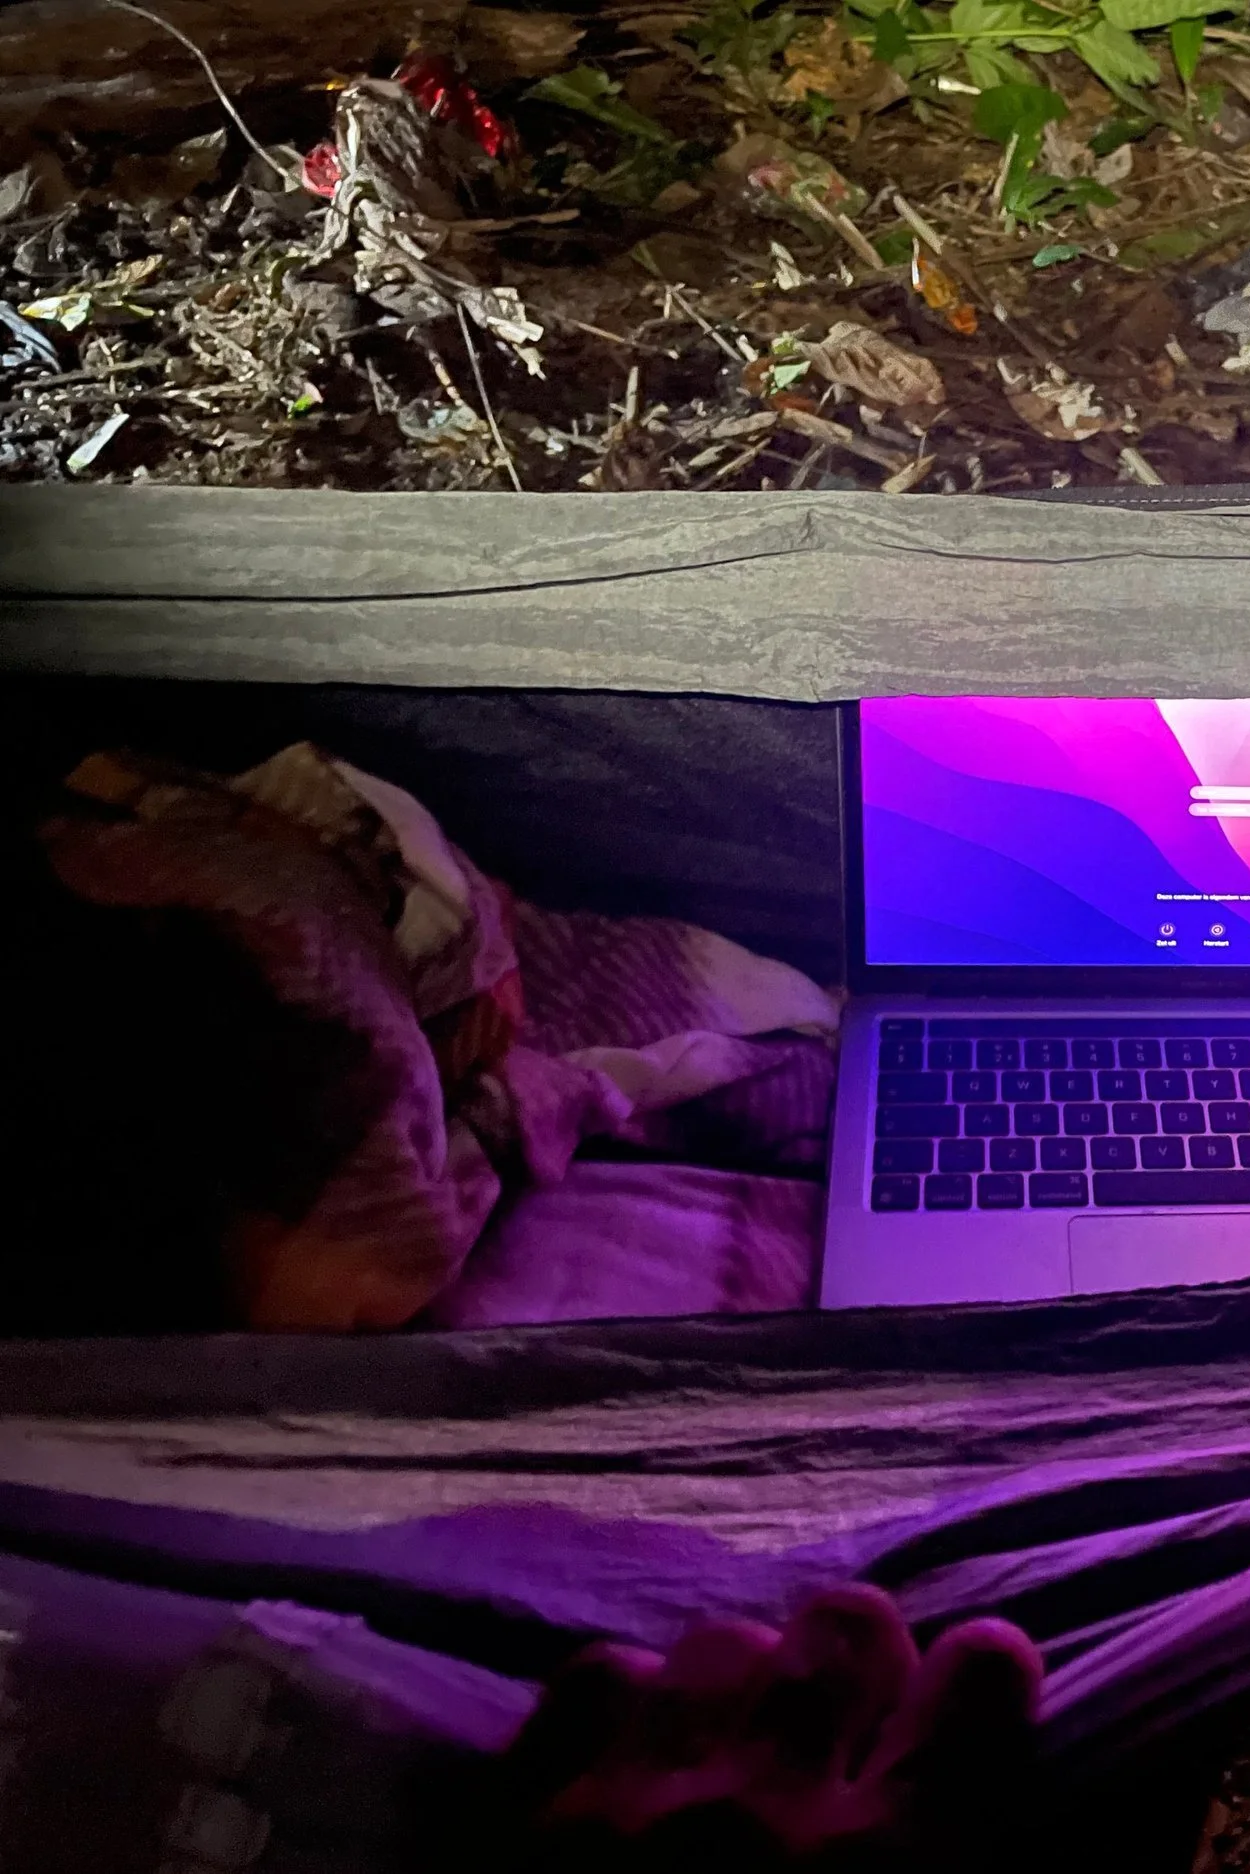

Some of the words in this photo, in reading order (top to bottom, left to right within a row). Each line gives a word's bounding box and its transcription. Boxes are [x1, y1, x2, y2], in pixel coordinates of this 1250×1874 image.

[1173, 893, 1202, 901] computer
[1203, 939, 1229, 947] Herstart
[1089, 1053, 1098, 1062] 4
[1136, 1052, 1145, 1062] 5
[1230, 1052, 1237, 1061] 7
[1017, 1080, 1030, 1090] W
[1163, 1079, 1171, 1089] T
[1210, 1079, 1219, 1089] Y
[1130, 1112, 1138, 1122] F
[1226, 1111, 1237, 1121] H
[1158, 1146, 1168, 1157] V
[1207, 1146, 1217, 1157] B
